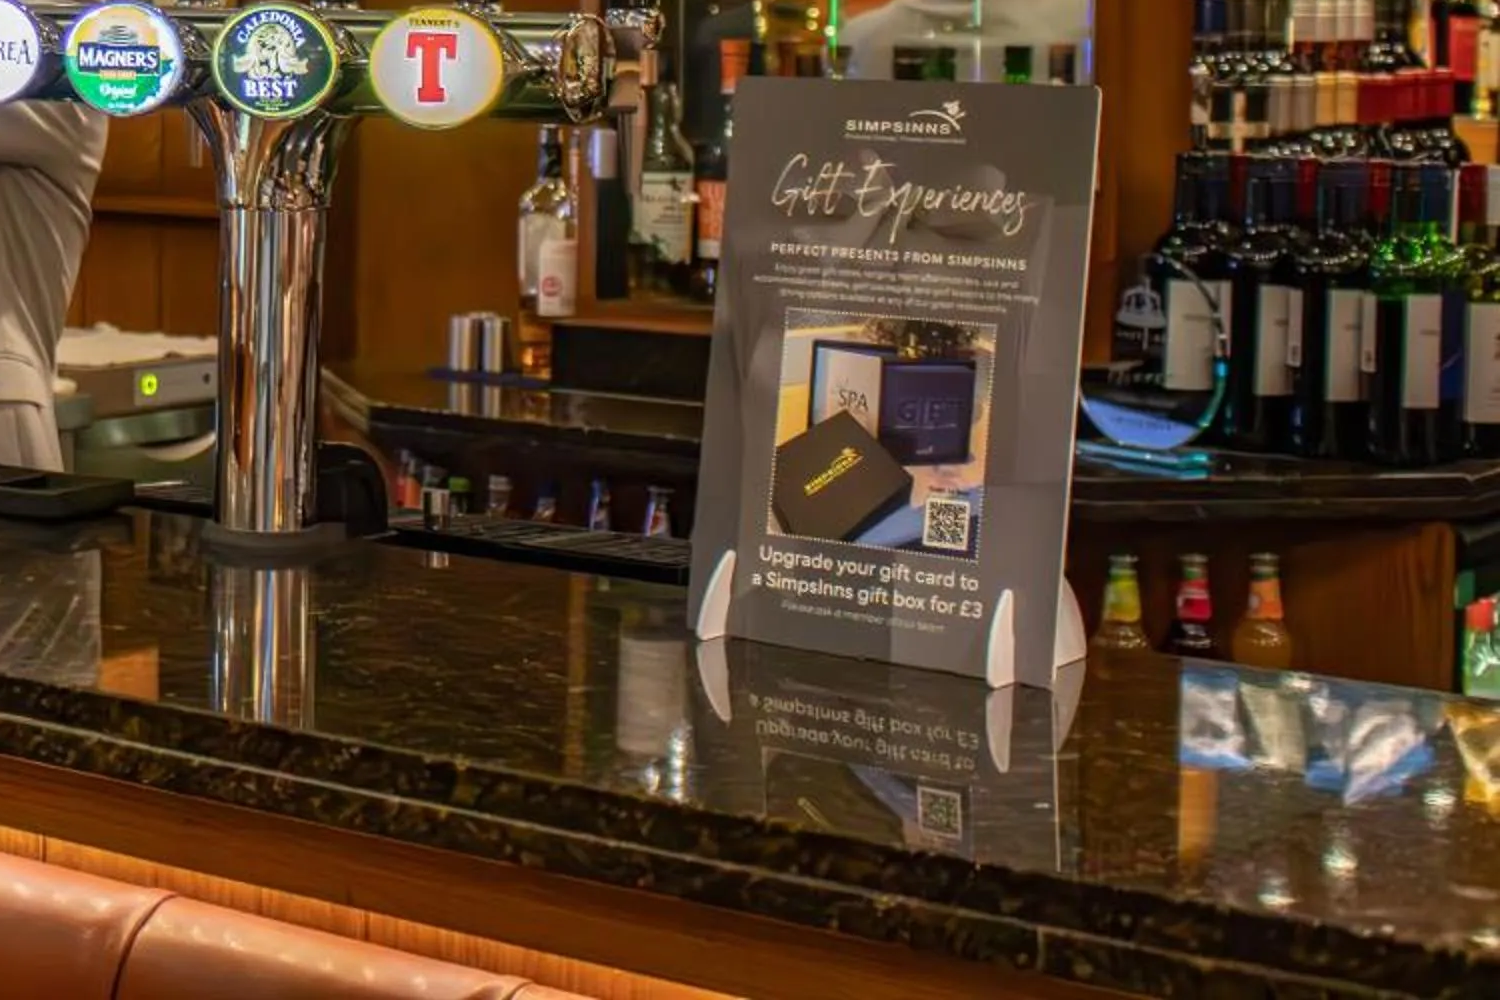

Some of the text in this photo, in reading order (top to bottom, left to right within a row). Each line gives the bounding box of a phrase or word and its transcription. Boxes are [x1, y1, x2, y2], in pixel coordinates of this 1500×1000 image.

[237, 11, 306, 48] CALEDONIA
[79, 49, 158, 69] MAGNERS
[406, 32, 458, 103] T
[243, 79, 298, 99] BEST
[845, 119, 952, 135] SIMPSINNS
[771, 153, 855, 217] Gift
[855, 159, 1027, 244] Experiences
[771, 242, 1027, 271] PERFECT PRESENTS FROM SIMPSINNS
[838, 389, 869, 412] SPA
[759, 545, 979, 592] Upgrade your gift card to
[751, 571, 983, 619] a SimpsInns gift box for £3
